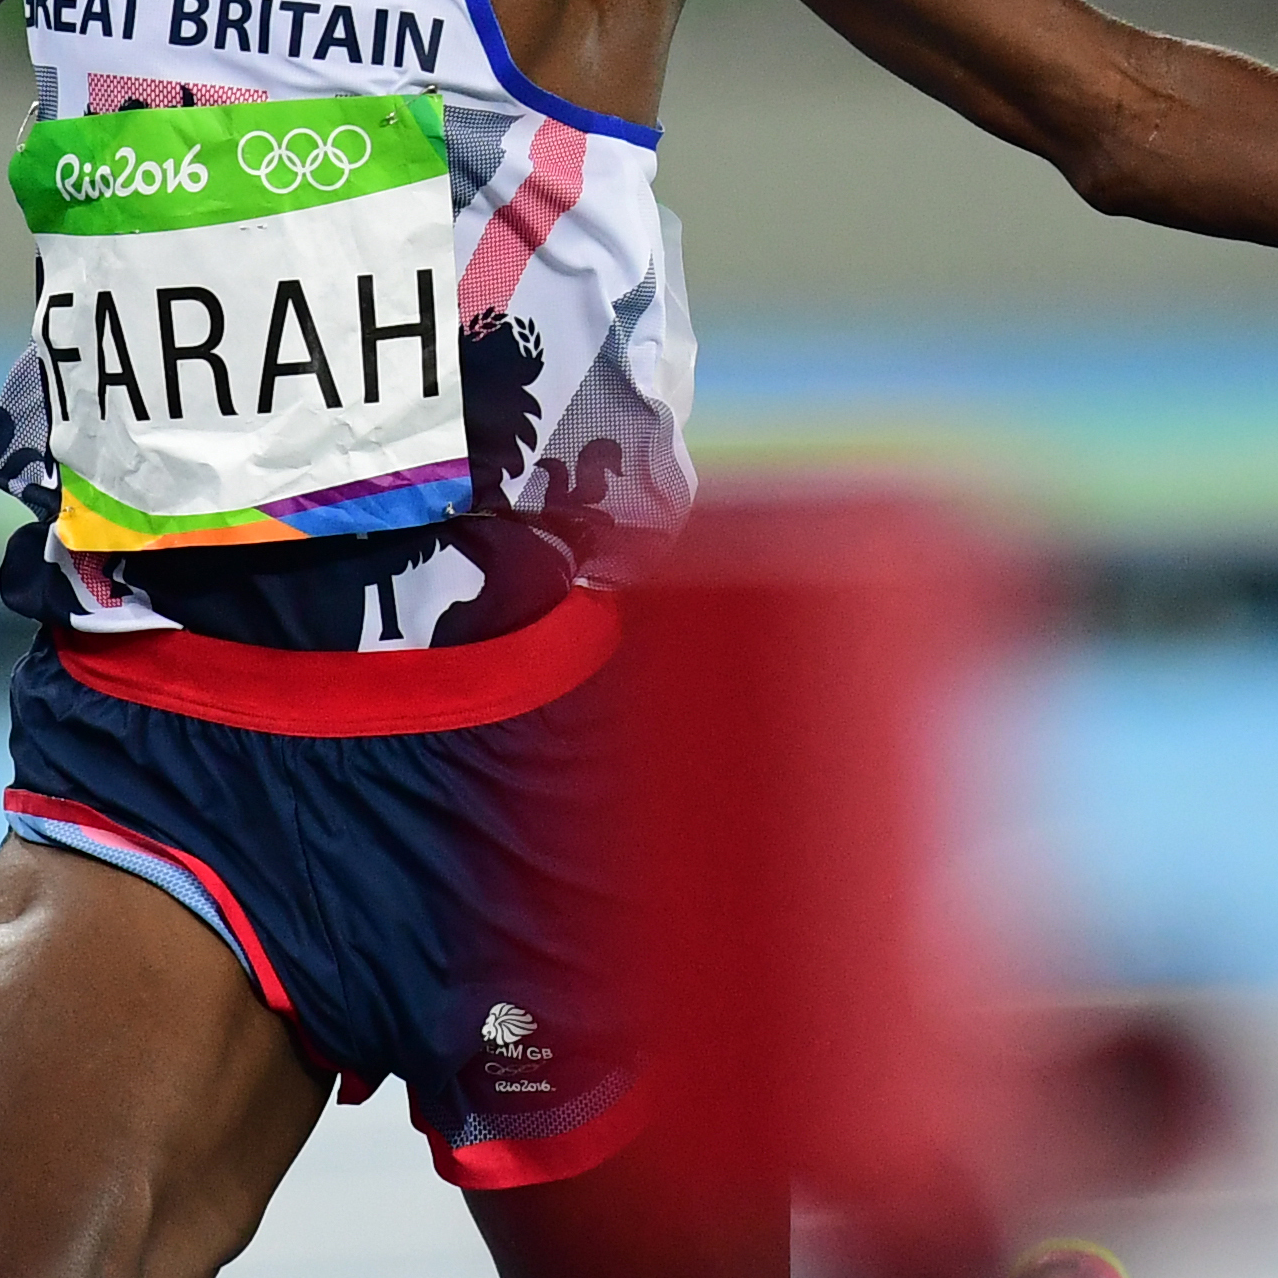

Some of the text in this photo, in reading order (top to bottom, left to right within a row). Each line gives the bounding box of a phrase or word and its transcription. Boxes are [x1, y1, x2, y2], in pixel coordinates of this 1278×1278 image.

[55, 143, 209, 202] Rio2016
[42, 268, 440, 423] FARAH
[480, 1042, 554, 1060] EAM GB
